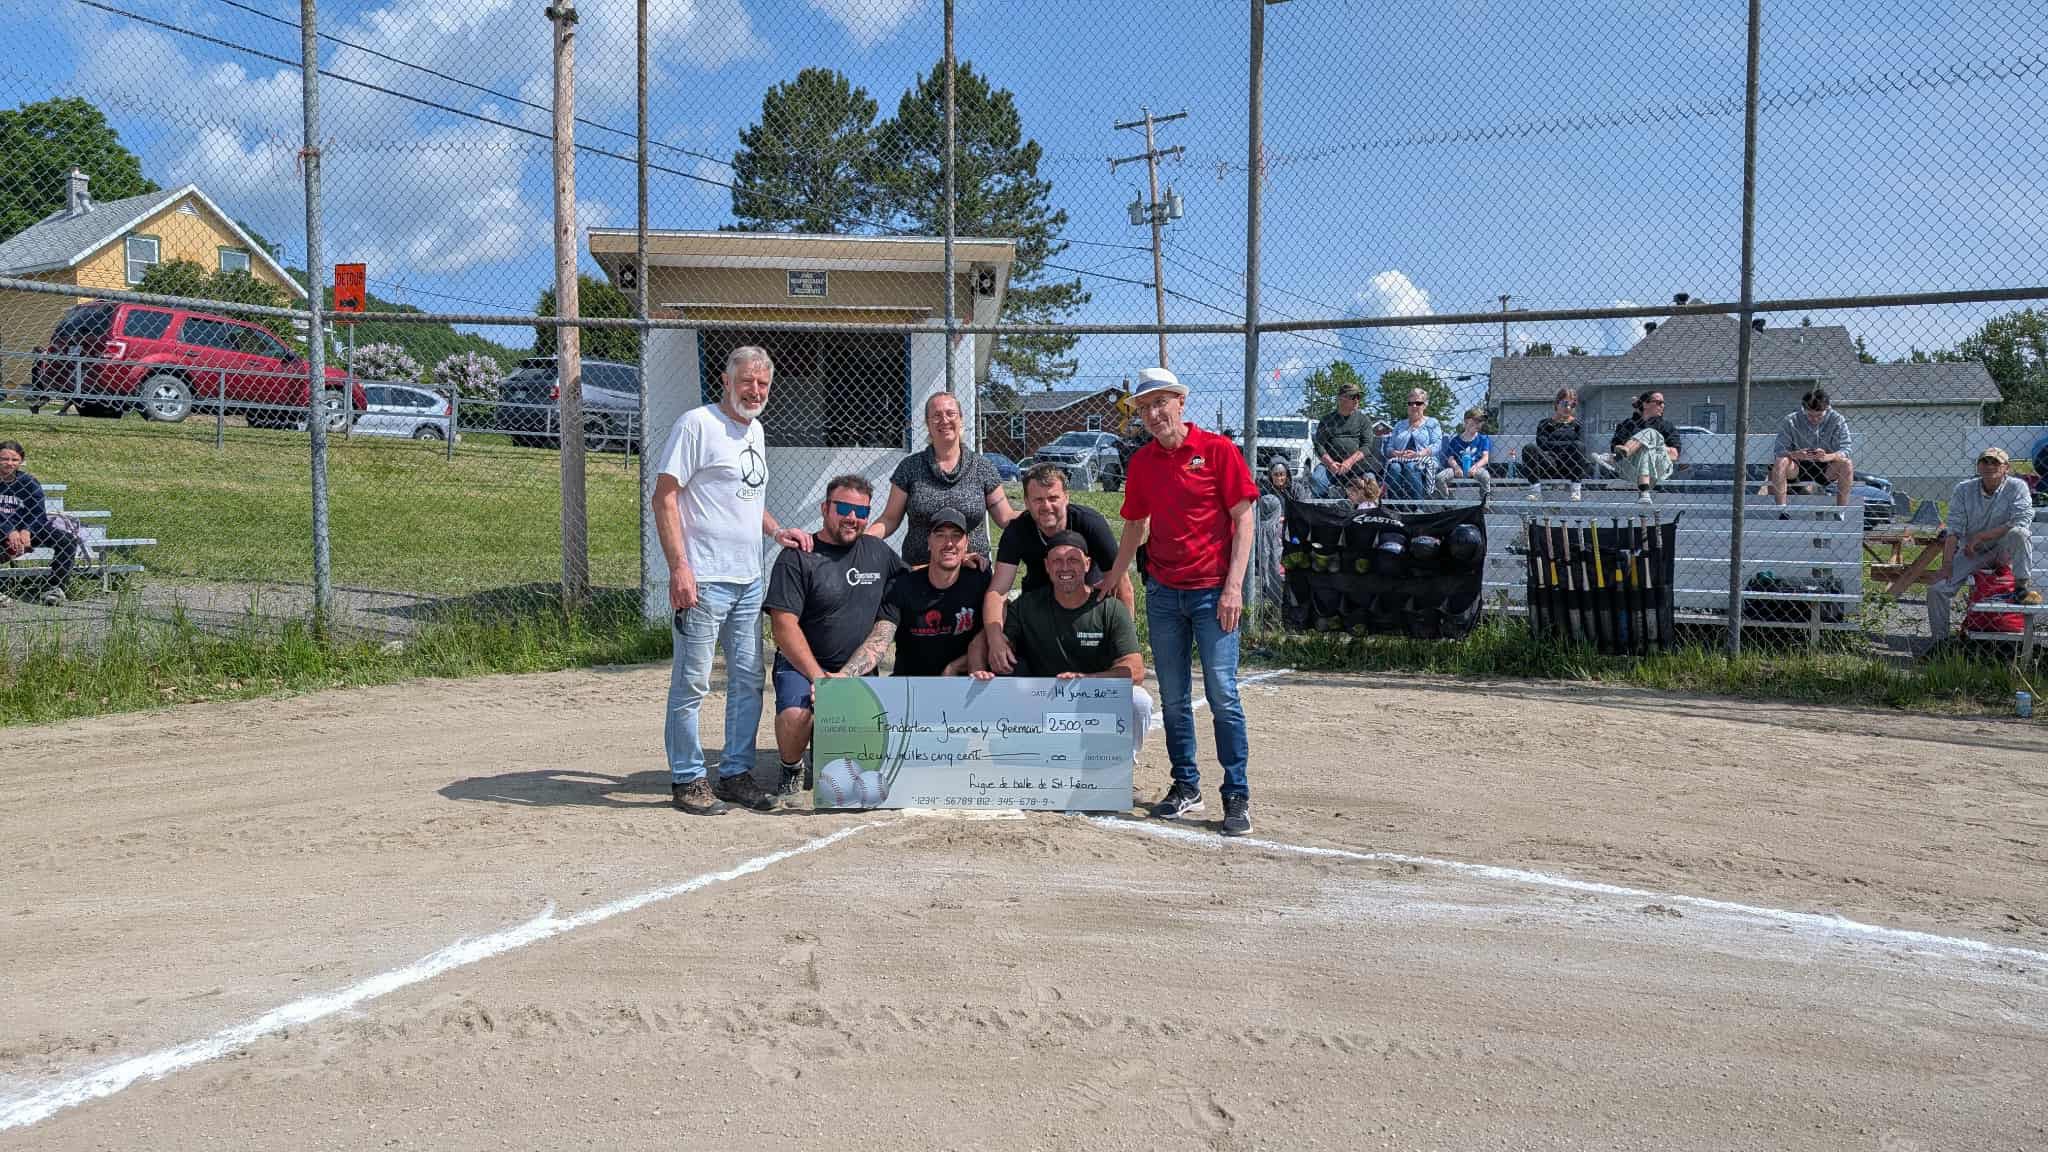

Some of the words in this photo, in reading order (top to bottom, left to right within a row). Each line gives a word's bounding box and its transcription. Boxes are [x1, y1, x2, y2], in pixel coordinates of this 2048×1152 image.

[336, 271, 363, 287] DETOUR
[1363, 515, 1405, 527] EASTON
[1117, 717, 1126, 734] $
